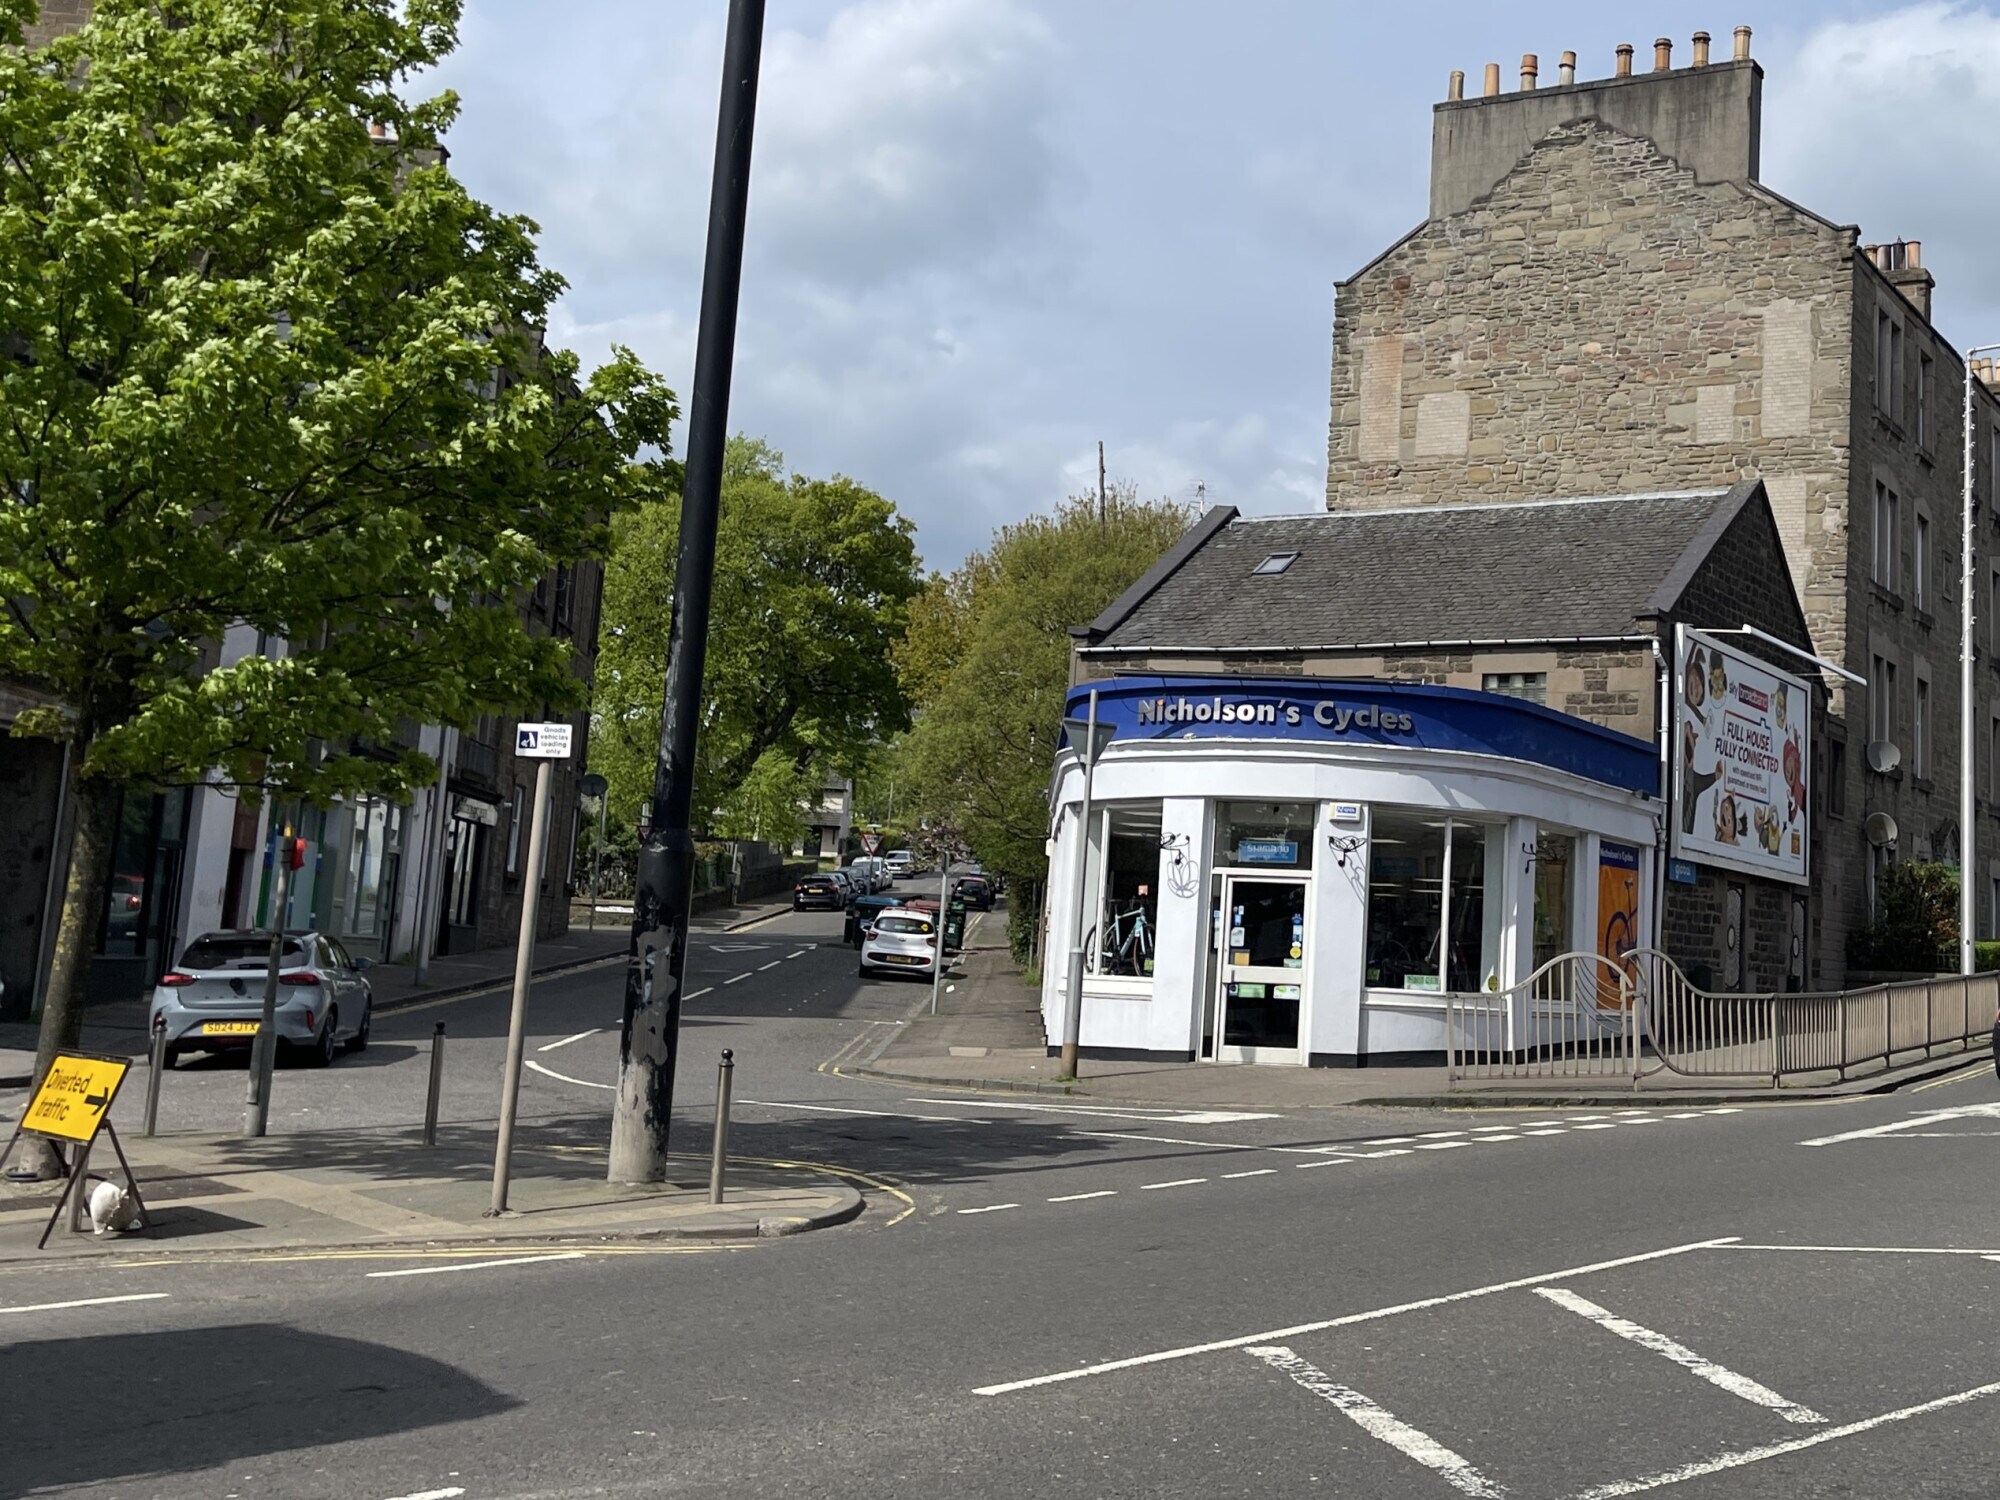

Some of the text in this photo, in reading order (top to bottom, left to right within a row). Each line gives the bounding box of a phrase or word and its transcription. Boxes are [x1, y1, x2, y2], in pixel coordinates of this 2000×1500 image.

[1138, 697, 1412, 731] Nicholson's Cycles
[541, 741, 567, 749] loading
[1727, 721, 1770, 752] FULL HOUSE
[1715, 737, 1779, 773] FULLY CONNECTED
[208, 1023, 257, 1032] SD24 JTX
[46, 1068, 94, 1094] Diverted
[35, 1096, 70, 1121] traffic
